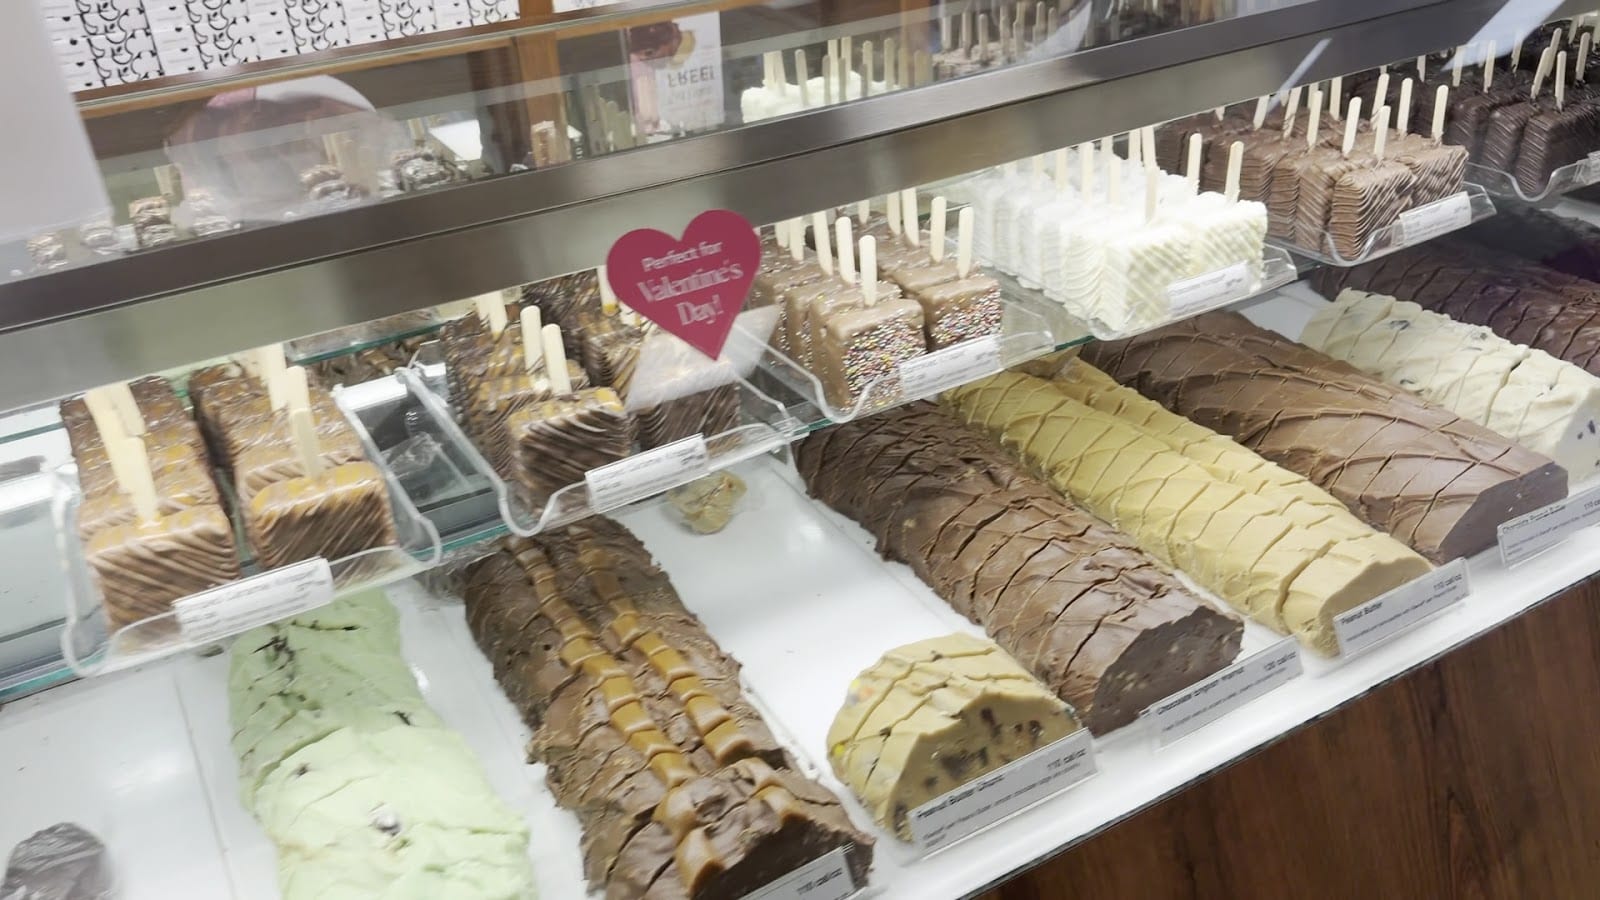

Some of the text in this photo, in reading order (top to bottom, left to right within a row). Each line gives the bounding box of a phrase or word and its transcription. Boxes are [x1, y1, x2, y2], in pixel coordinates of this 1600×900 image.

[641, 241, 723, 272] Perfect for
[637, 260, 744, 303] Valentine's
[675, 294, 724, 326] Day!
[1341, 600, 1383, 625] Peanut Butter
